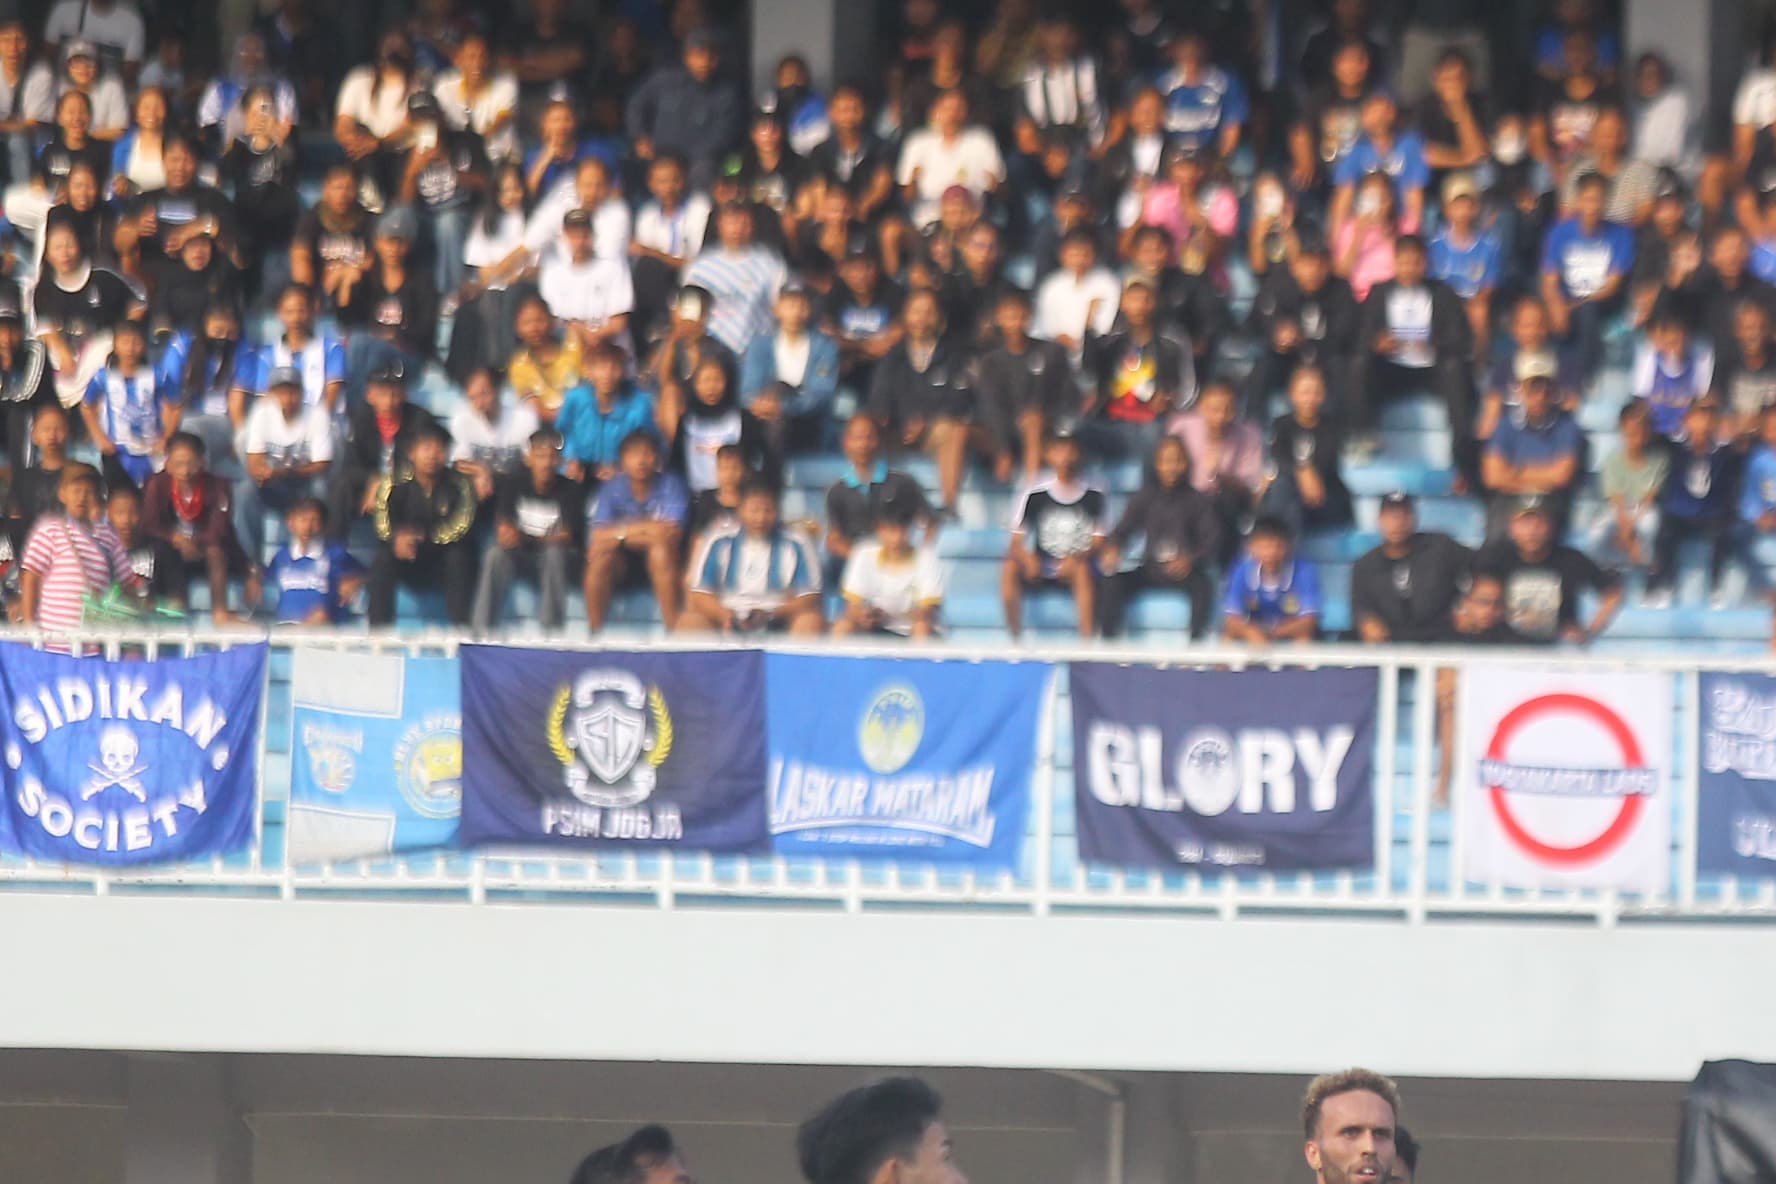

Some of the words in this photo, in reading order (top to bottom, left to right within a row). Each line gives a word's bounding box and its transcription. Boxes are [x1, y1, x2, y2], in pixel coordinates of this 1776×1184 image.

[12, 680, 228, 748] SIDIKAN
[16, 778, 208, 853] SOCIETY
[543, 804, 602, 838] PSIM
[603, 806, 684, 840] JOGJA
[766, 755, 868, 828] LASKAR
[870, 765, 997, 835] MATARAM
